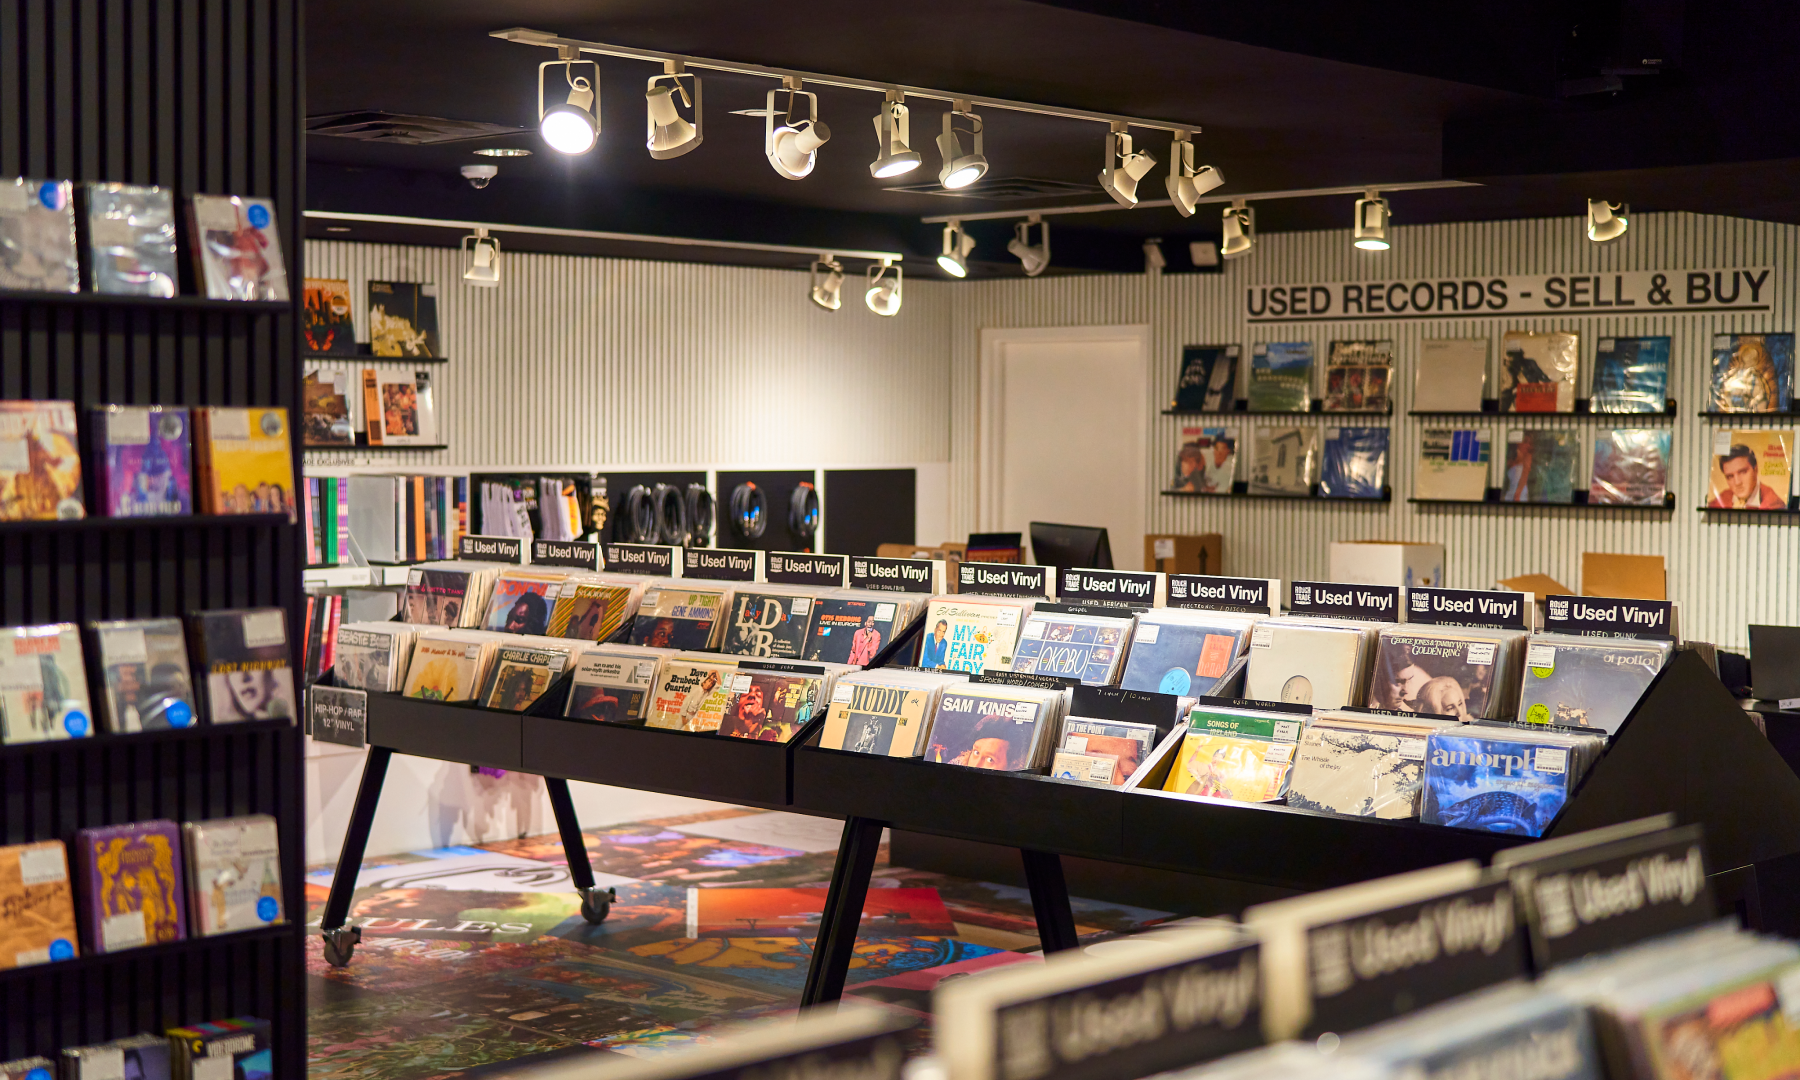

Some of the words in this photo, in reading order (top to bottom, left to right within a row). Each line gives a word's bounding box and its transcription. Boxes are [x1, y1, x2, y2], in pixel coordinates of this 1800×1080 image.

[1247, 286, 1331, 316] USED
[1342, 279, 1508, 313] RECORDS
[1544, 275, 1635, 308] SELL
[1647, 273, 1673, 305] &
[1687, 270, 1770, 304] BUY
[475, 541, 497, 554] Used
[498, 543, 519, 558] Vinyl
[549, 545, 571, 558] Used
[574, 547, 595, 562] Vinyl
[621, 550, 645, 563] Used
[647, 551, 670, 567] Vinyl
[700, 554, 726, 568] Used
[728, 556, 752, 572] Vinyl
[785, 559, 812, 573] Used
[814, 560, 840, 578] Vinyl
[870, 563, 899, 578] Used
[901, 565, 929, 582] Vinyl
[977, 569, 1009, 585] Used
[1011, 571, 1041, 590] Vinyl
[496, 580, 549, 597] DONOV
[1083, 576, 1116, 592] Used
[1119, 578, 1151, 597] Vinyl
[1172, 586, 1187, 594] TRADE
[1191, 582, 1226, 599] Used
[1229, 584, 1263, 604] Vinyl
[688, 594, 697, 605] UP
[699, 595, 719, 607] TIGHT!
[1315, 589, 1352, 606] Used
[1356, 591, 1393, 611] Vinyl
[1412, 600, 1429, 608] TRADE
[1550, 600, 1568, 609] ROUGH
[672, 606, 688, 617] GENE
[688, 607, 715, 619] AMMONS
[936, 607, 949, 616] Ed
[948, 608, 981, 618] Sullivan
[1433, 595, 1474, 613] Used
[1478, 598, 1517, 619] Vinyl
[1550, 608, 1568, 616] TRADE
[1573, 603, 1617, 622] Used
[1622, 606, 1664, 628] Vinyl
[1435, 620, 1463, 628] USED
[1465, 622, 1504, 630] COUNTRY
[338, 630, 370, 647] BEASTIE
[953, 625, 976, 641] MY
[1581, 630, 1608, 638] USED
[1614, 631, 1638, 640] PUNK
[1391, 637, 1413, 645] GEORGE
[1412, 638, 1430, 647] JONES
[1434, 640, 1456, 649] TAMMY
[502, 650, 529, 662] CHARLIE
[530, 653, 551, 664] CHAPL
[949, 642, 985, 660] FAIR
[1412, 646, 1442, 656] GOLDEN
[1442, 648, 1460, 658] RING
[211, 661, 238, 674] LOST
[240, 659, 287, 672] HIGHWAY
[690, 668, 708, 677] Dave
[671, 675, 700, 685] Brubeck
[979, 675, 1005, 685] SPOKEN
[665, 683, 692, 693] Quartet
[1097, 688, 1102, 696] 7
[656, 697, 684, 706] Favorite
[674, 692, 687, 701] My
[847, 685, 910, 715] MUDDY
[315, 703, 344, 716] HIP-HOP
[348, 708, 362, 718] RAP
[656, 704, 681, 714] Things
[942, 697, 974, 713] SAM
[977, 701, 1017, 718] KINIS
[697, 711, 712, 719] This
[1397, 711, 1418, 719] FOLK
[335, 719, 354, 731] VINYL
[1068, 722, 1076, 730] TO
[1076, 723, 1087, 733] THE
[1087, 725, 1106, 735] POINT
[1207, 720, 1229, 729] SONGS
[1229, 721, 1240, 730] OF
[1508, 720, 1537, 731] USED
[1573, 862, 1642, 923] Used
[1638, 847, 1701, 905] Vinyl
[1352, 905, 1438, 979] Used
[1434, 888, 1515, 955] Vinyl
